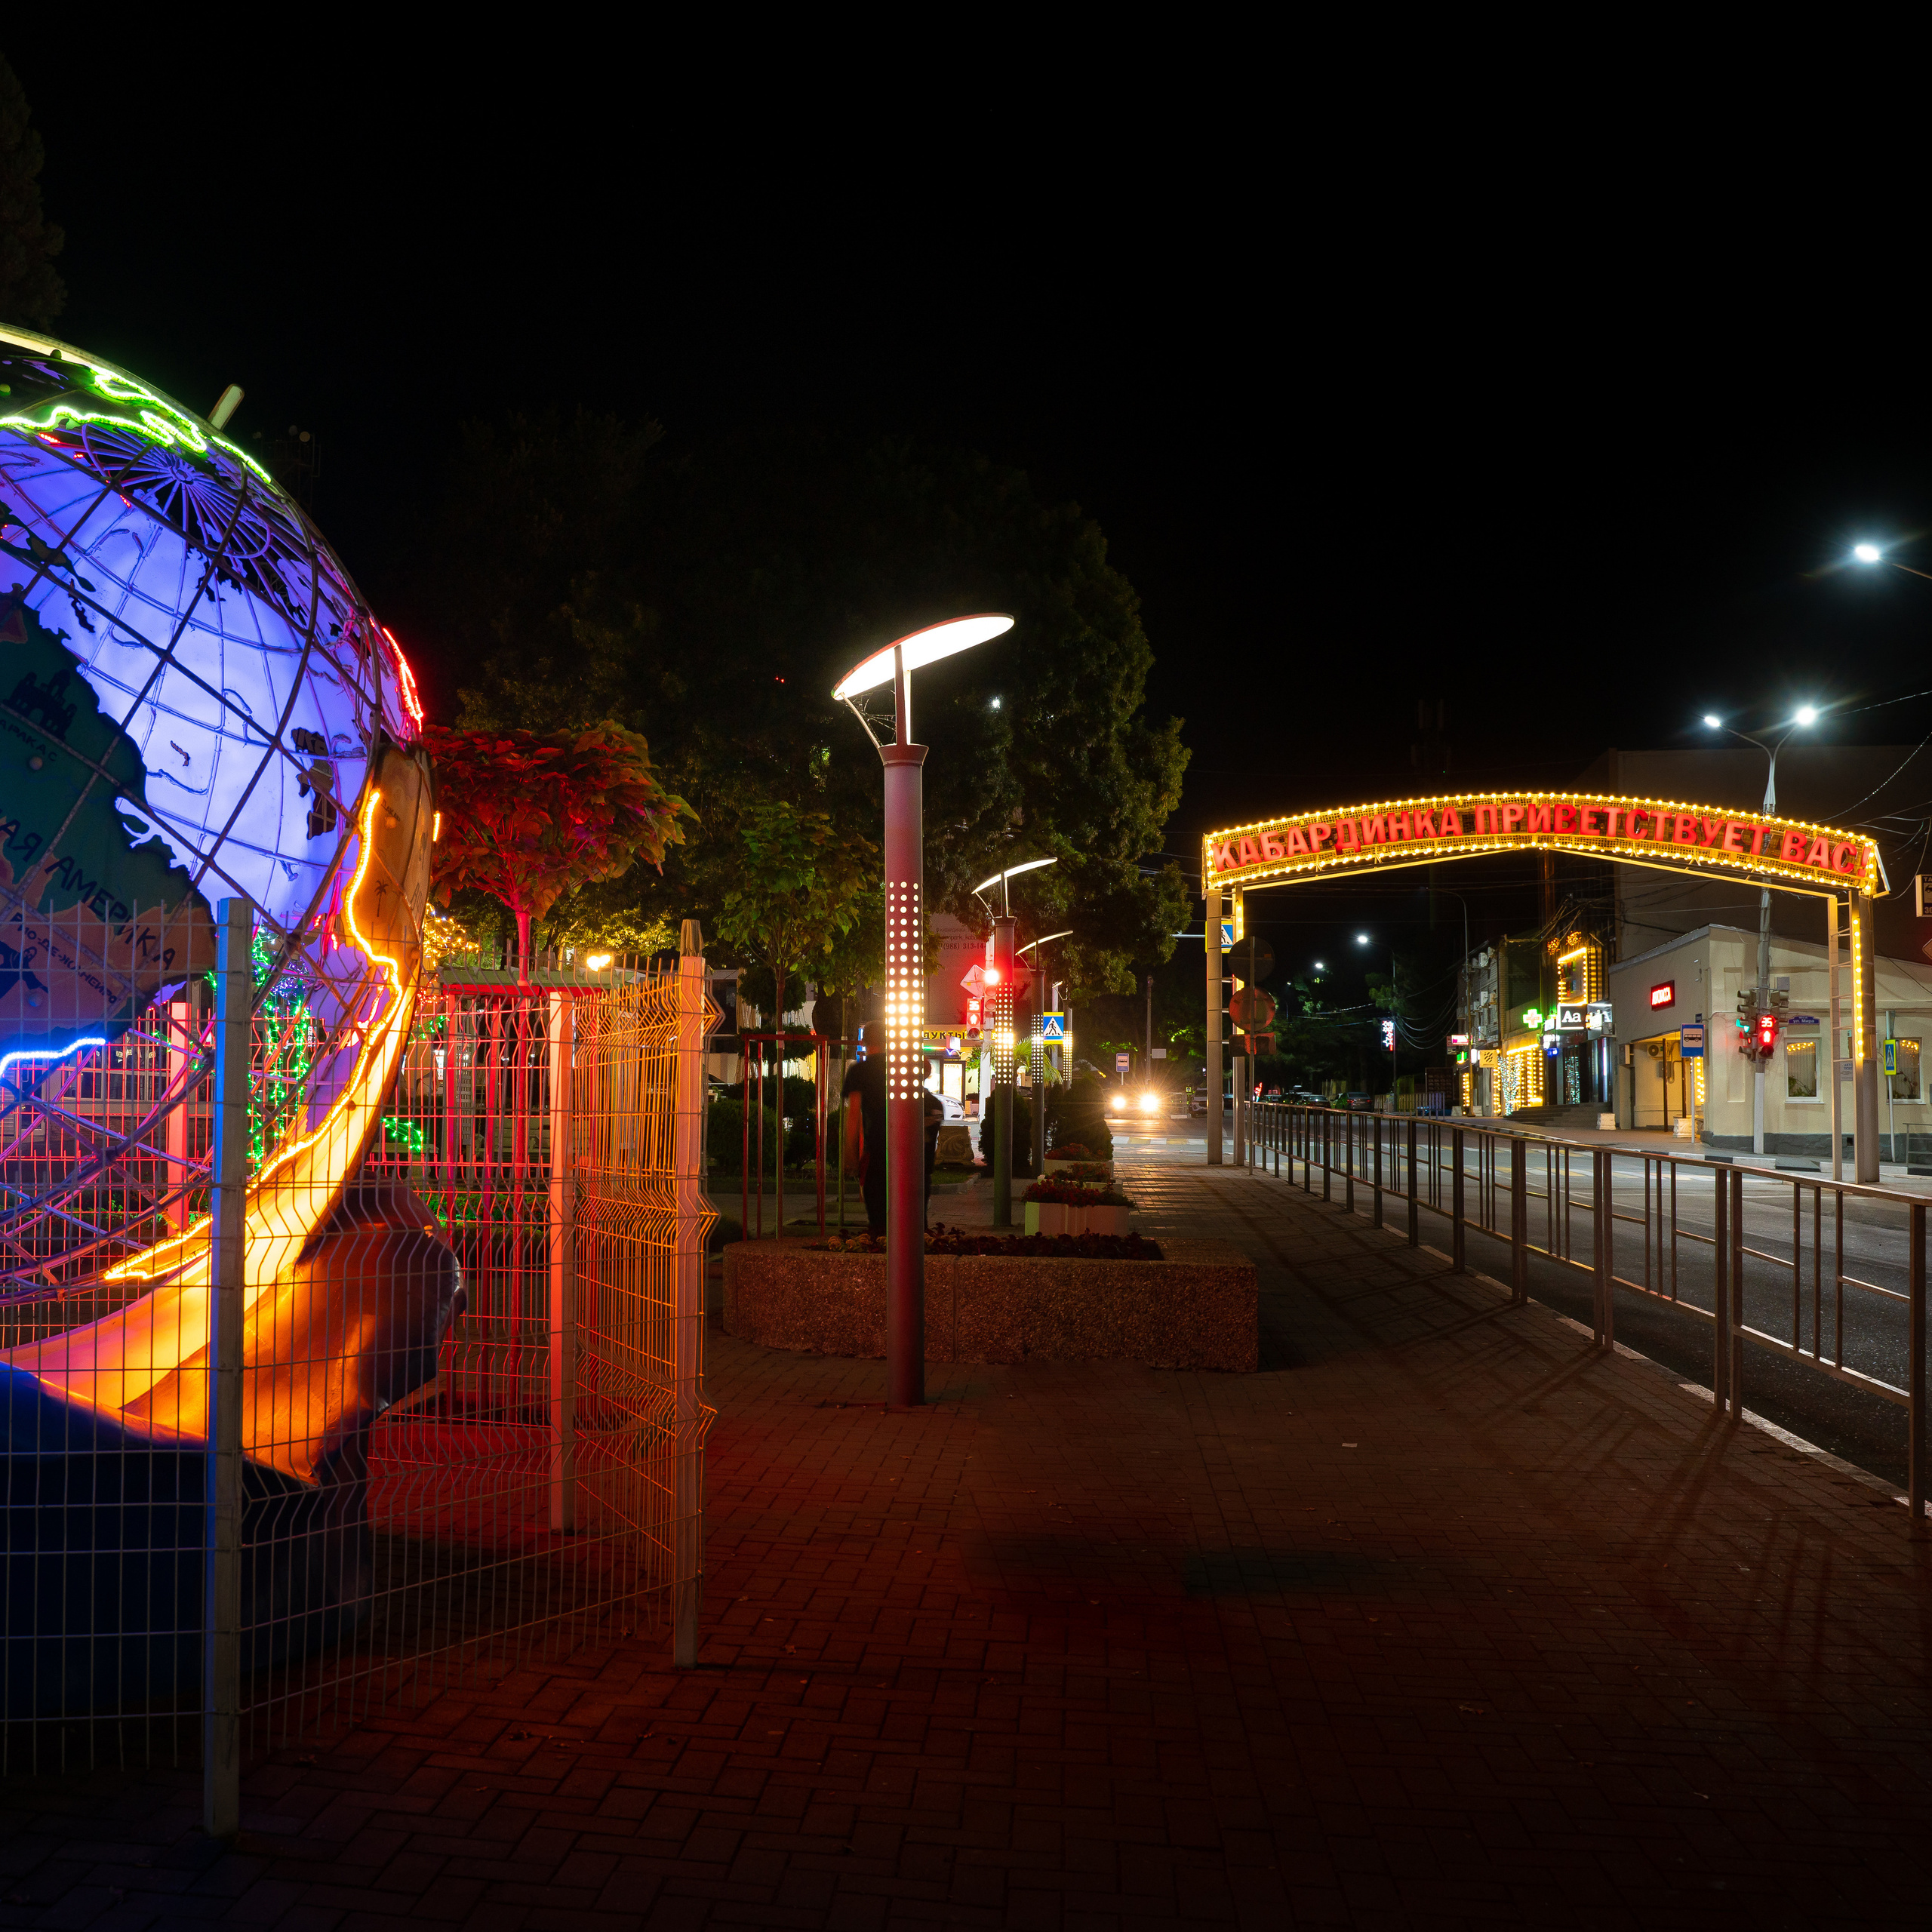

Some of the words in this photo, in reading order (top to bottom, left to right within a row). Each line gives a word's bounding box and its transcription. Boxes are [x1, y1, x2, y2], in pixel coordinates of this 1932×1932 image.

[1211, 806, 1463, 872] КАБАРДИНКА
[1475, 803, 1770, 856] ПРИВЕТСТВУЕТ
[1780, 830, 1872, 878] ВАС!
[44, 856, 176, 971] АМЕРИКА
[969, 1000, 980, 1011] 35
[1761, 1017, 1773, 1027] 35
